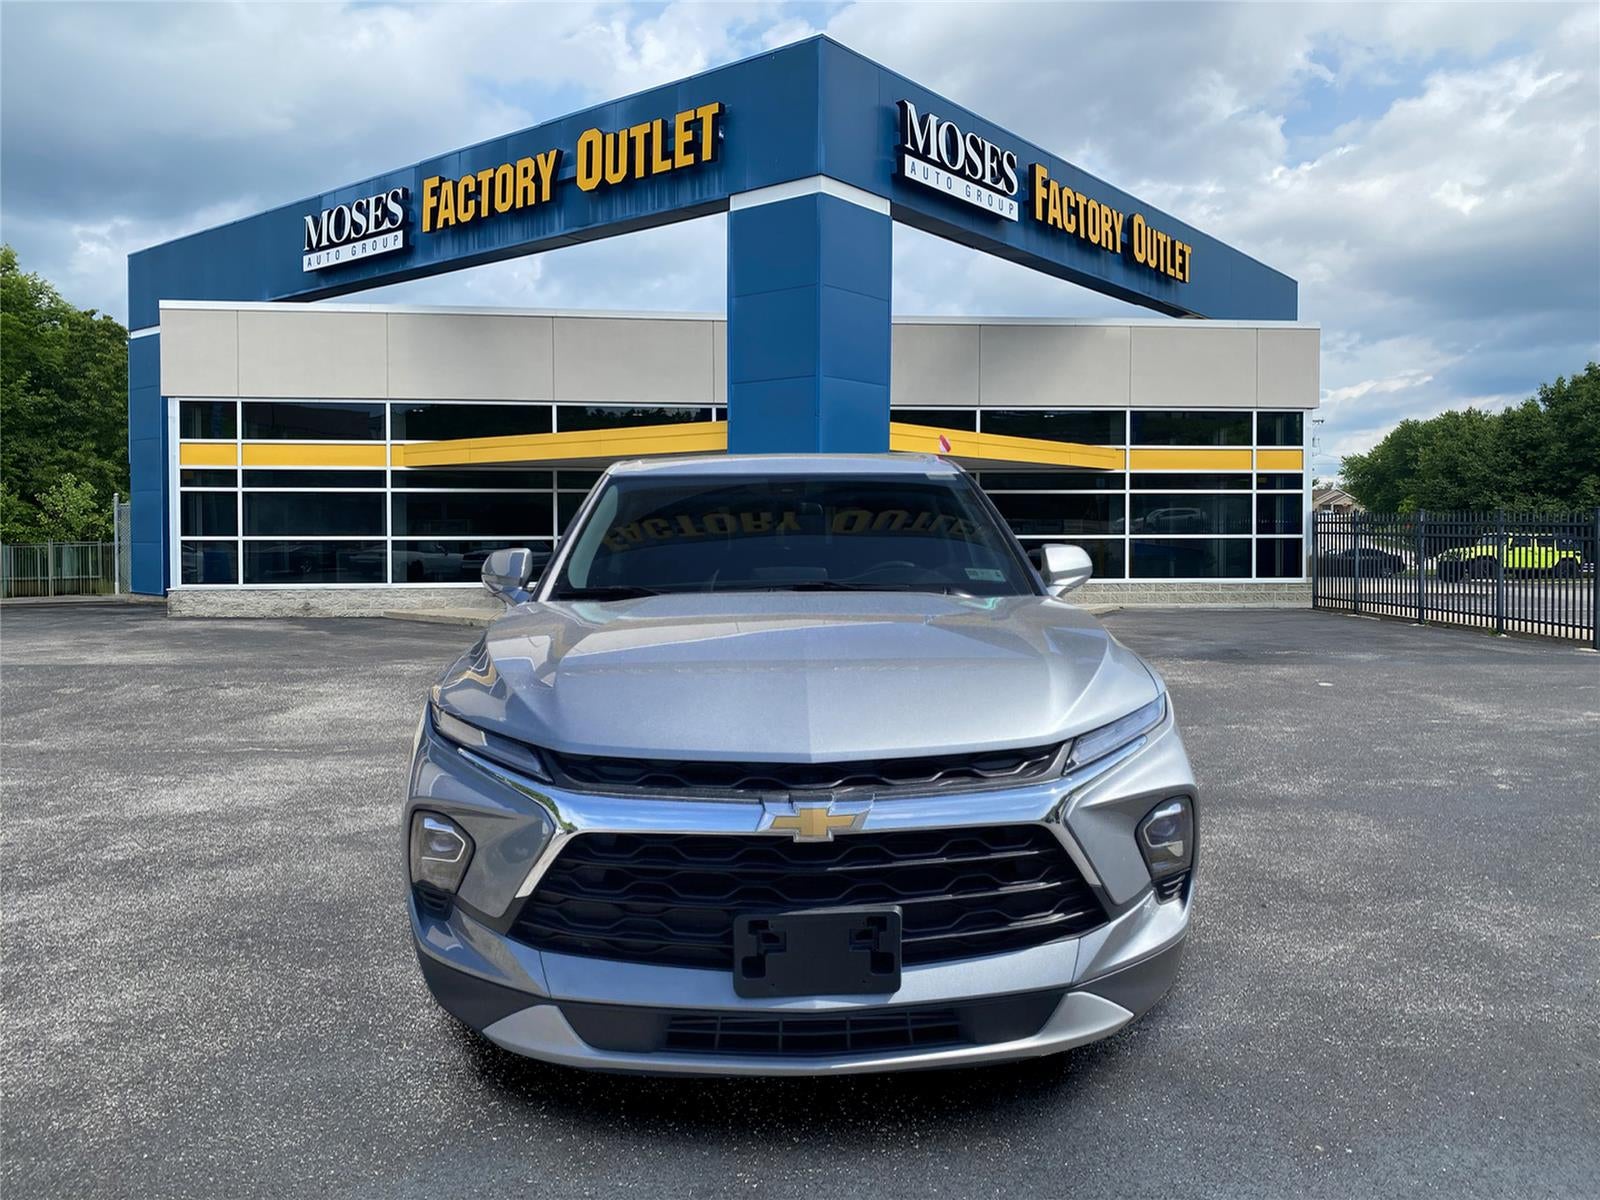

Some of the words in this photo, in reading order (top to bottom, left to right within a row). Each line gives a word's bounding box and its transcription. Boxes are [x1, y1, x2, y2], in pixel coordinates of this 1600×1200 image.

[422, 147, 560, 233] FACTORY
[576, 101, 720, 192] OUTLET
[904, 100, 1018, 196] MOSES
[910, 161, 953, 190] AUTO
[965, 184, 1014, 215] GROUP
[303, 187, 404, 251] MOSES
[307, 250, 340, 268] AUTO
[351, 234, 399, 257] GROUP
[1034, 163, 1124, 254] FACTORY
[1132, 212, 1192, 283] OUTLET
